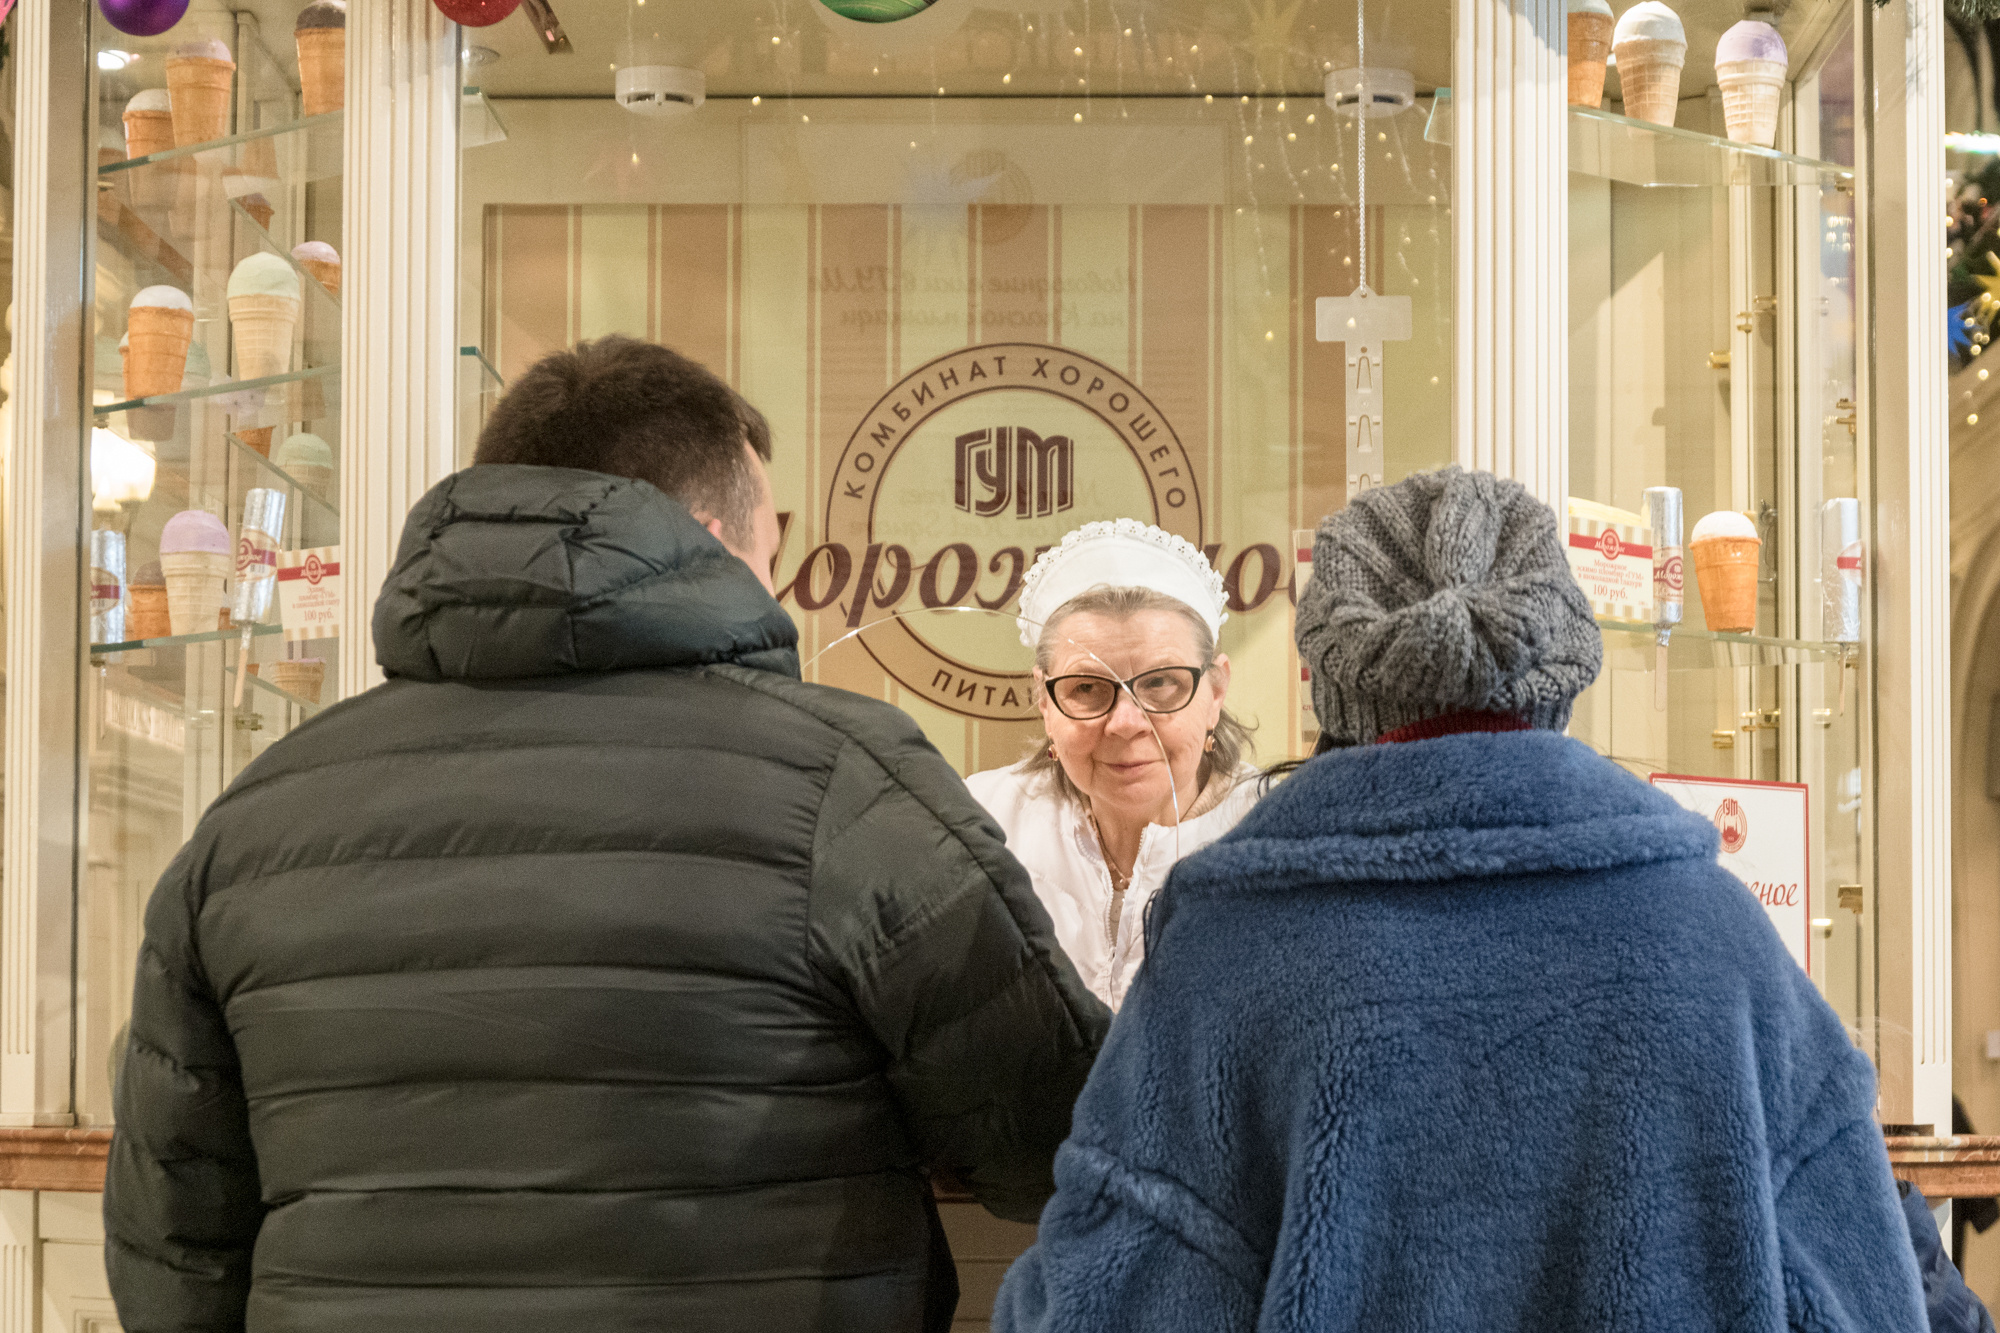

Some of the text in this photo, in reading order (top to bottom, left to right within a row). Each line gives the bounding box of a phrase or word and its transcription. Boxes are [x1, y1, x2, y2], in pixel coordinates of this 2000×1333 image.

[844, 356, 1007, 500] КОМБИНАТ
[1031, 357, 1186, 508] ХОРОШЕГО
[954, 425, 1074, 520] ГУМ
[1593, 583, 1629, 601] 100 руб.
[304, 607, 335, 623] 100 руб.
[931, 668, 1033, 707] ПИТА
[1744, 881, 1799, 907] еное
